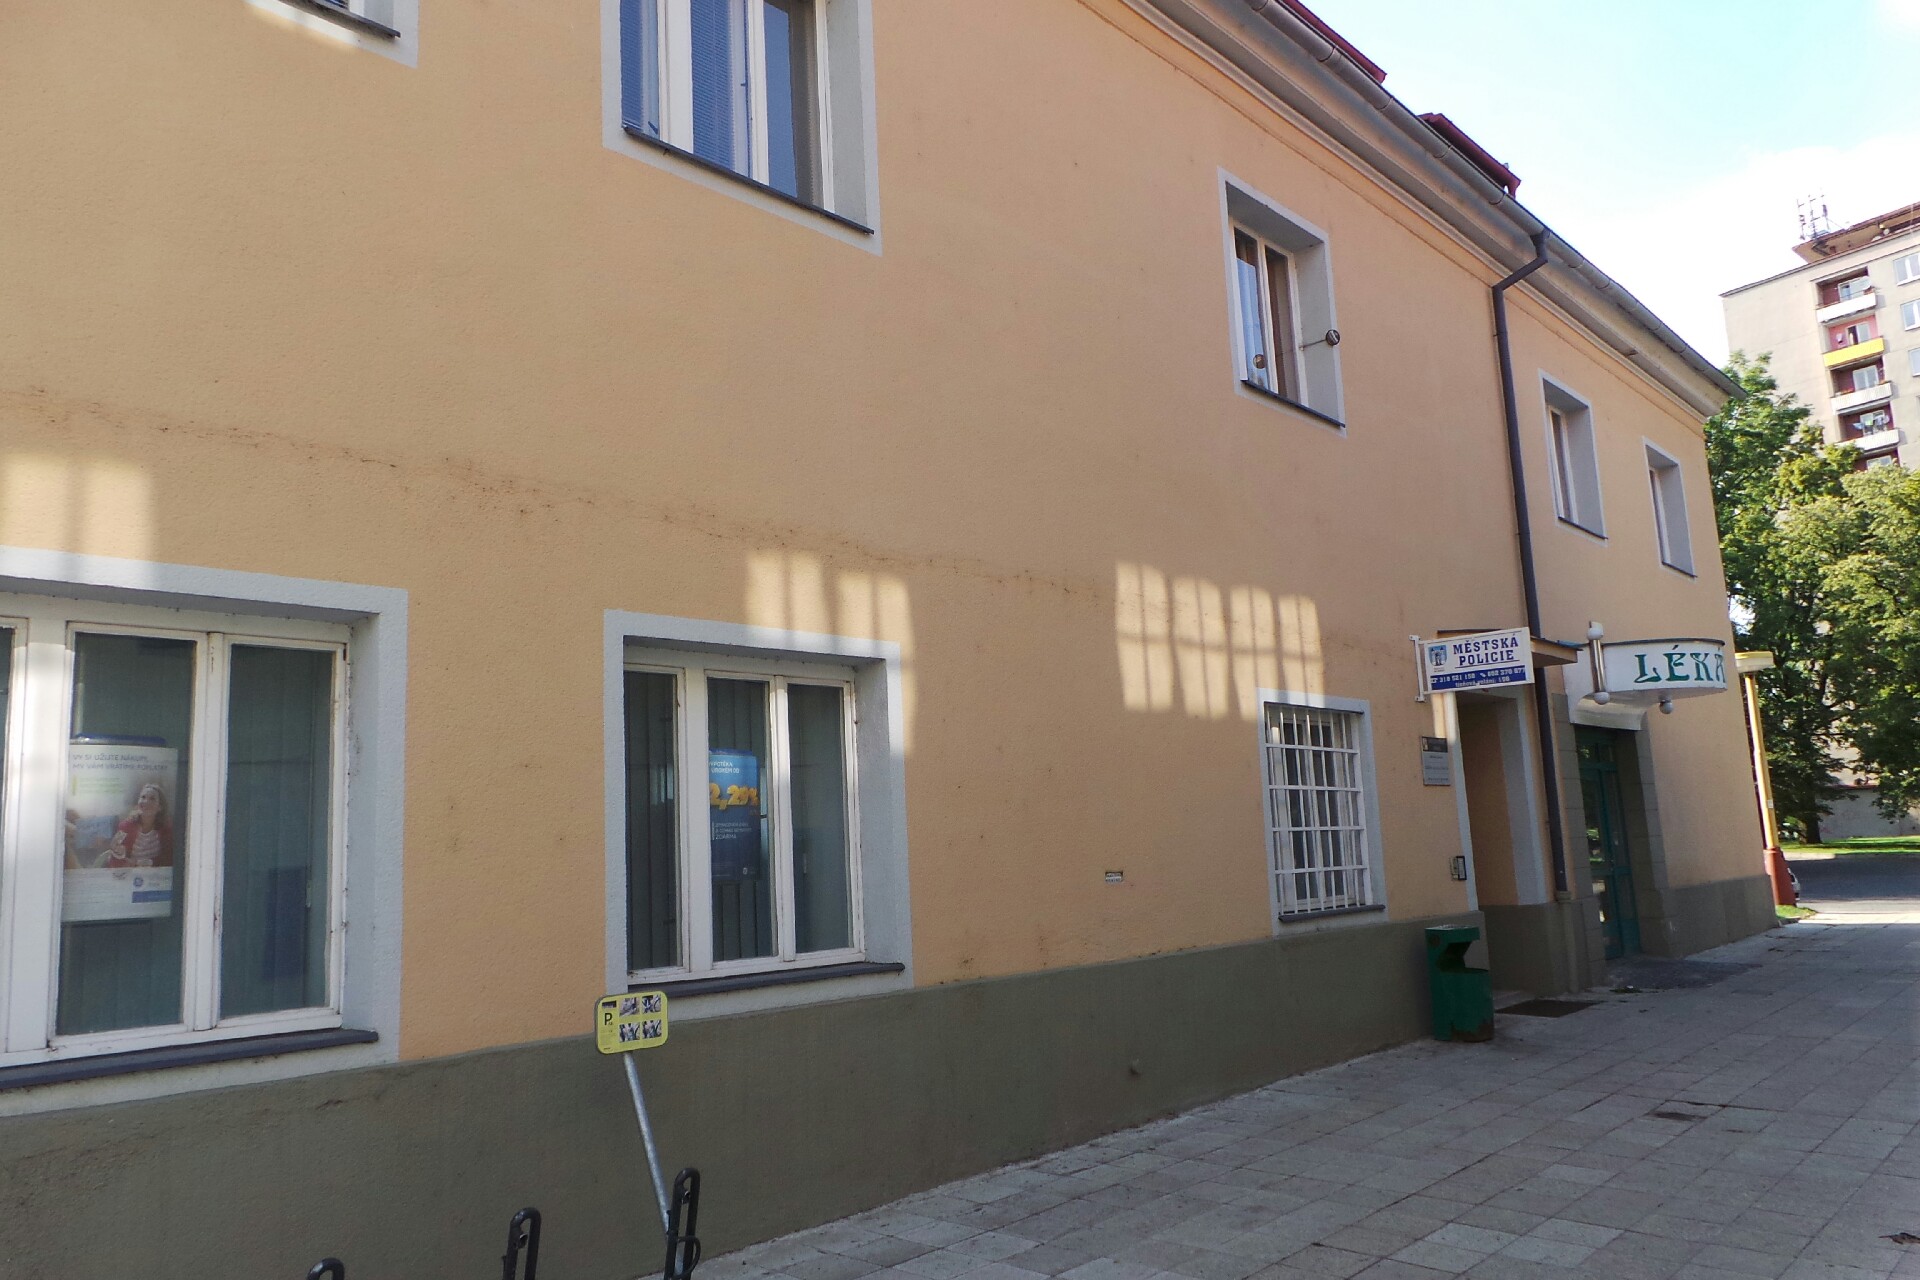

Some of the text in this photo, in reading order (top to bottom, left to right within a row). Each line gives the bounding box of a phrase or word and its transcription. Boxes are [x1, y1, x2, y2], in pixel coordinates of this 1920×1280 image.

[1453, 634, 1518, 654] MĚSTSKÁ
[1459, 650, 1514, 666] POLICIE
[605, 1012, 612, 1025] P
